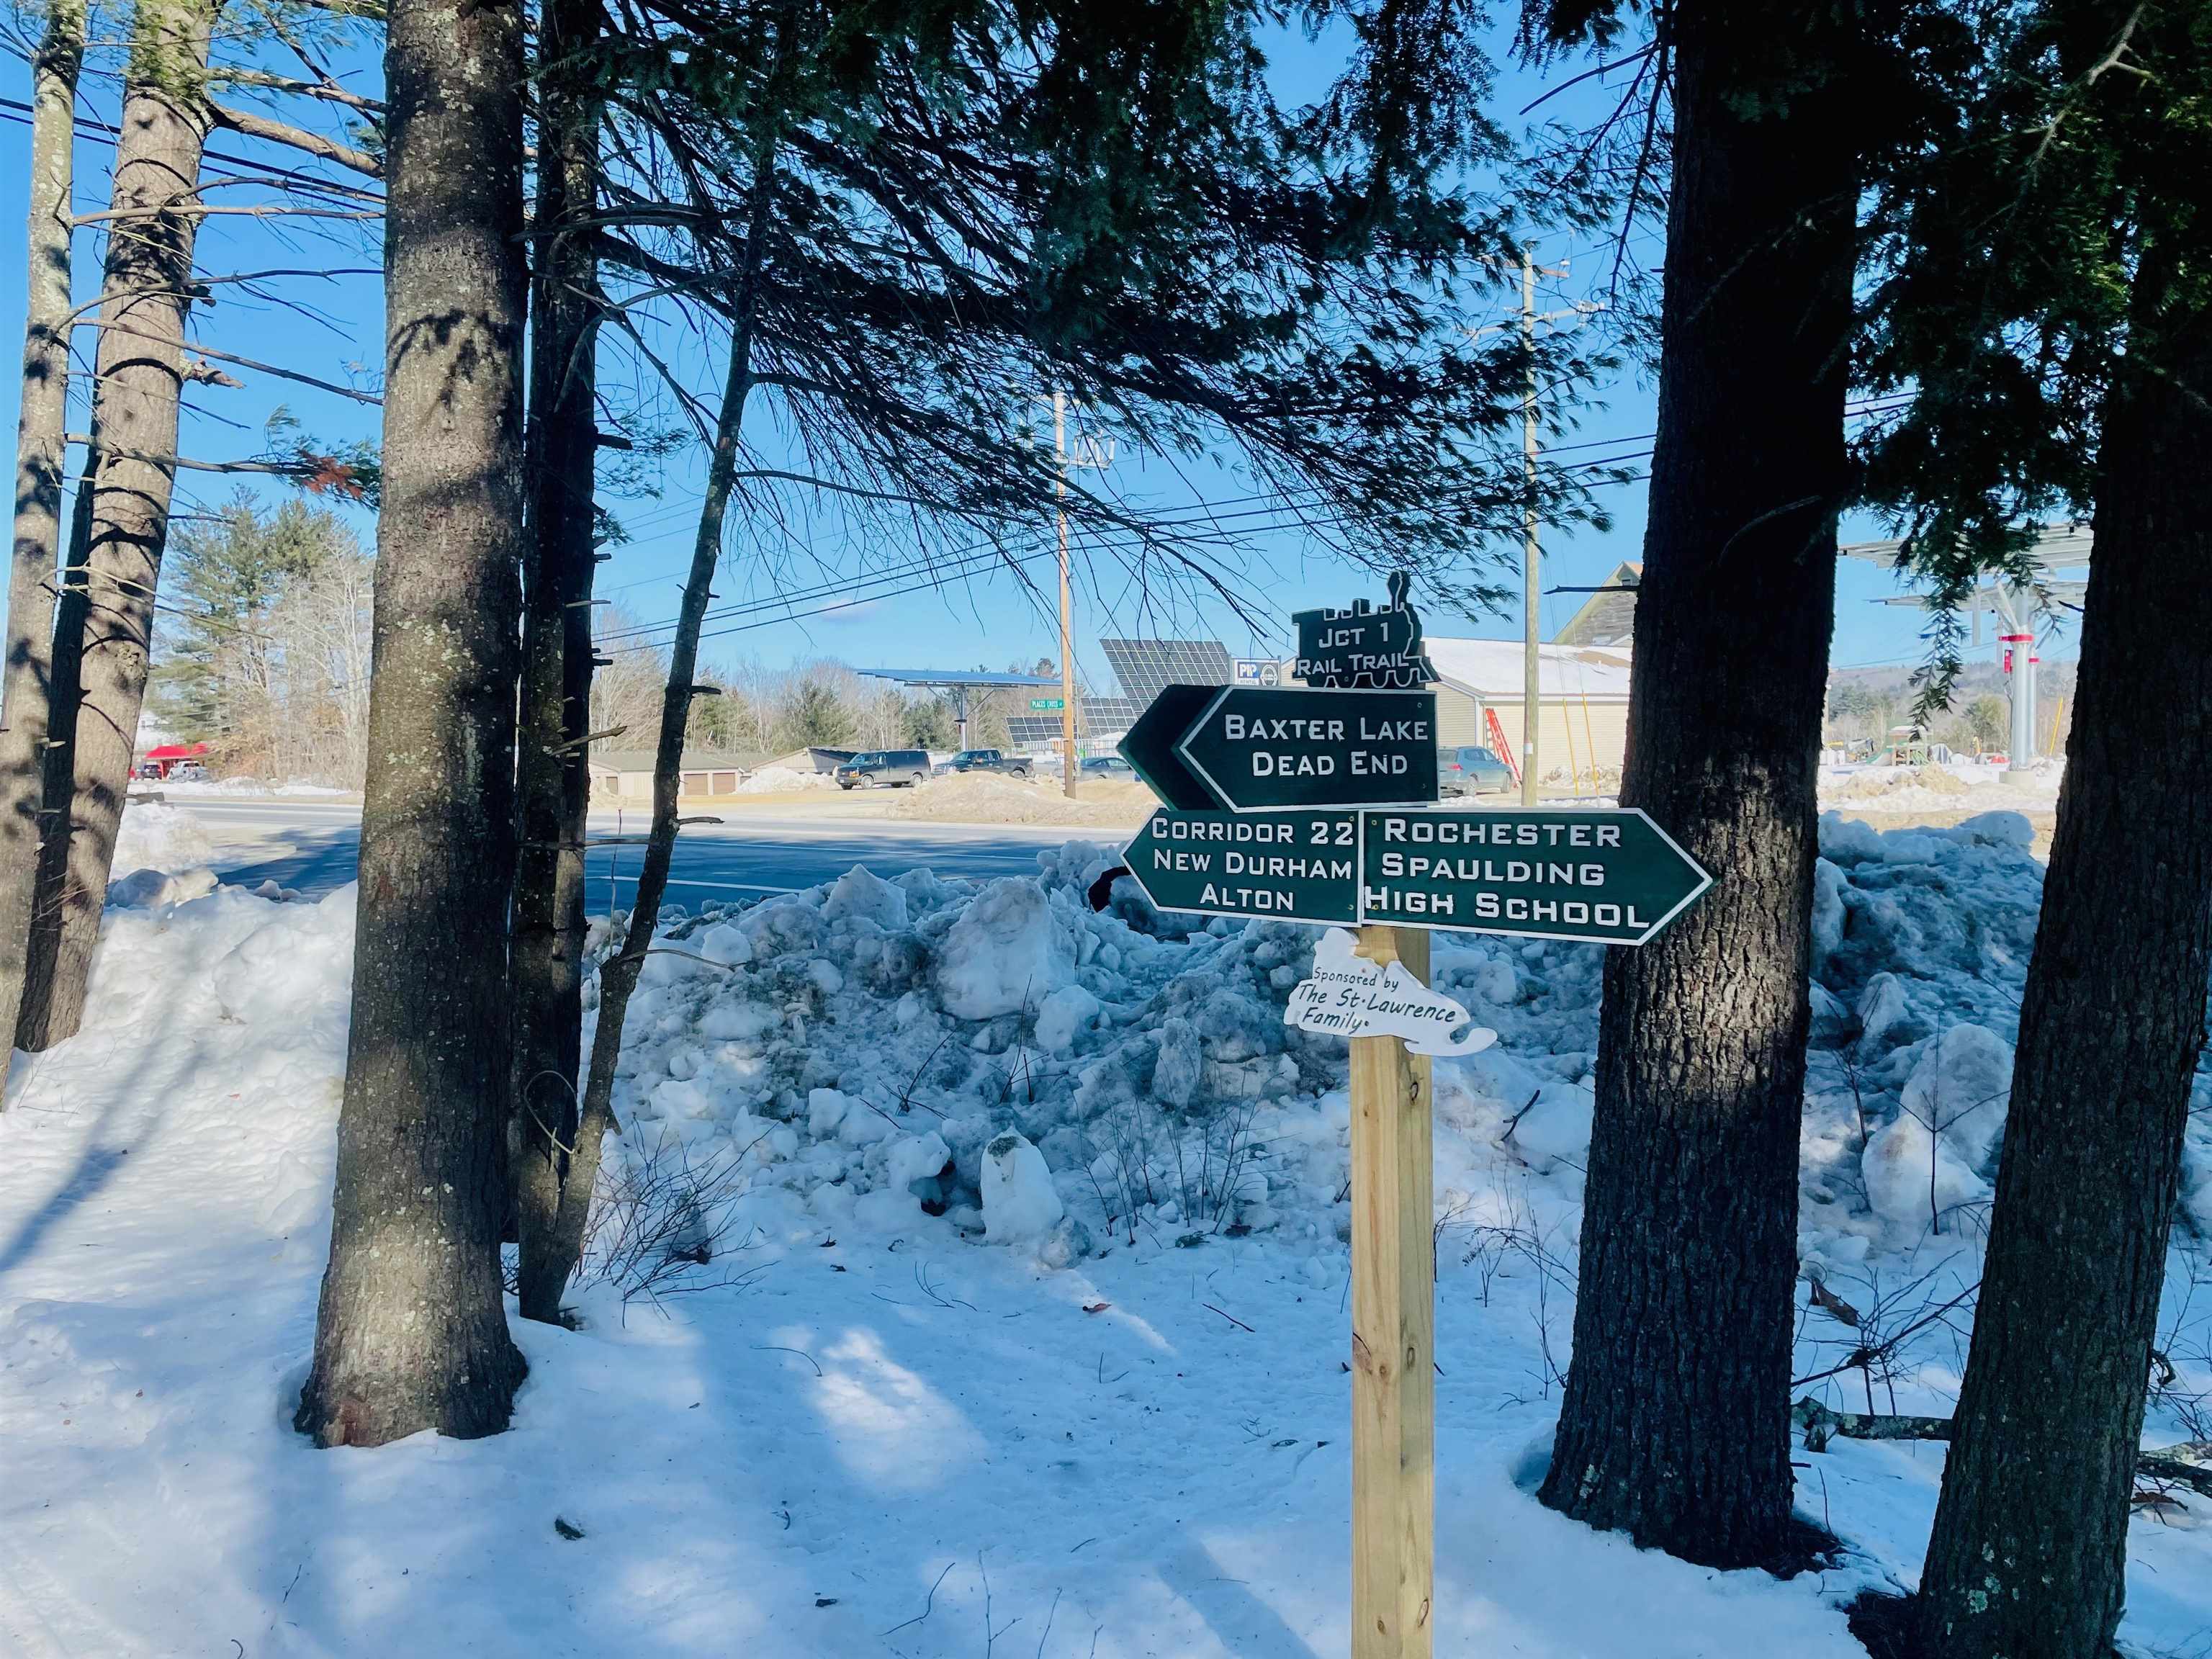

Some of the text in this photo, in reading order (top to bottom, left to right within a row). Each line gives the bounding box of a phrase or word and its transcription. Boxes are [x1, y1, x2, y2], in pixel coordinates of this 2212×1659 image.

[1380, 622, 1388, 642] 1
[1239, 663, 1257, 677] PIP
[1298, 652, 1409, 676] RAIL TRAIL
[1225, 714, 1429, 742] BAXTER LAKE
[1252, 750, 1408, 777] DEAD END
[1152, 817, 1354, 845] CORRIDOR 22
[1384, 818, 1622, 848] ROCHESTER
[1154, 848, 1352, 880] NEW DURHAM
[1381, 852, 1605, 886] SPAULDING
[1200, 883, 1293, 911] ALTON
[1364, 885, 1650, 929] HIGH SCHOOL
[1313, 967, 1399, 992] Sponsored by
[1298, 984, 1328, 1004] The
[1367, 993, 1456, 1023] Lawrence
